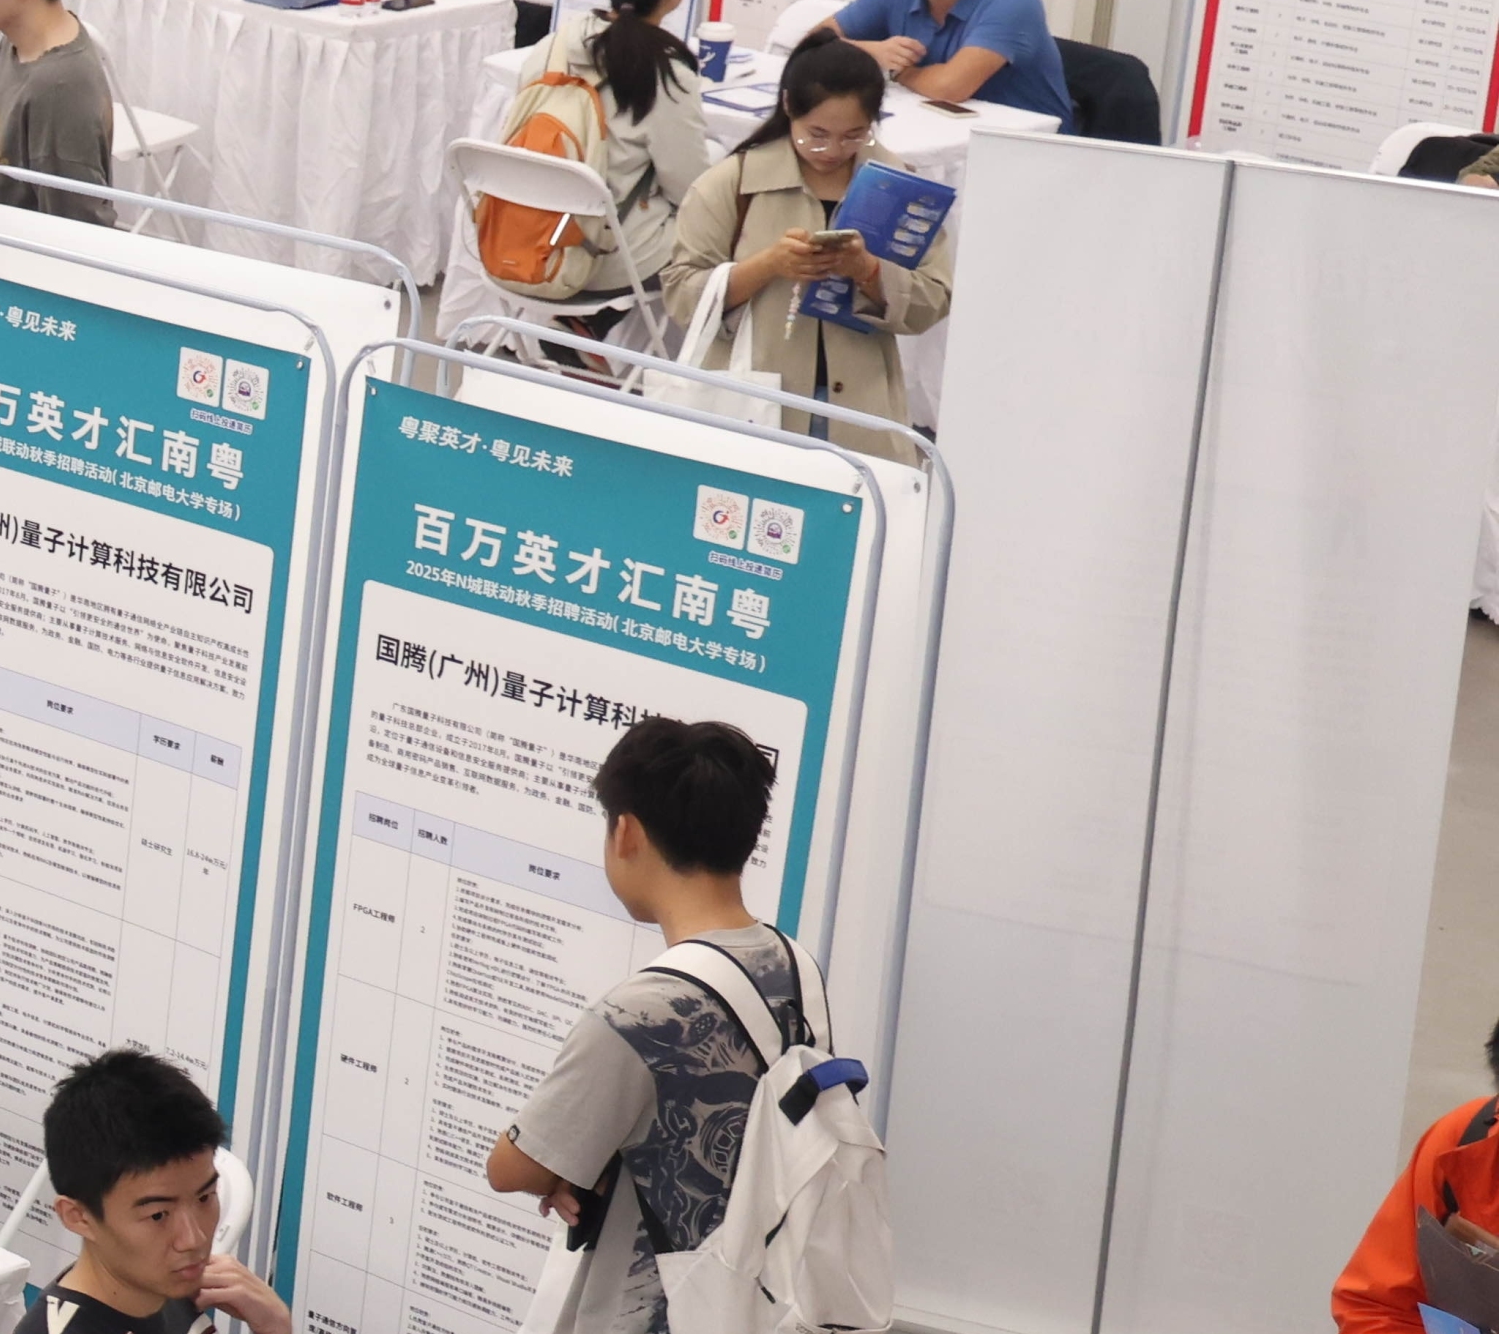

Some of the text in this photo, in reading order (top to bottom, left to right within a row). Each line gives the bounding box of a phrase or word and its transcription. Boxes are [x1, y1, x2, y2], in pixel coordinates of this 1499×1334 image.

[398, 413, 574, 479] 粤聚英才·粤见未来
[411, 502, 773, 641] 百万英才汇南粤
[404, 559, 768, 675] 2025年N城联动秋季招聘活动(北京邮电大学专场)
[416, 825, 450, 846] 招聘人数
[352, 900, 396, 926] FPGA工程师
[324, 1190, 365, 1214] 软件工程师
